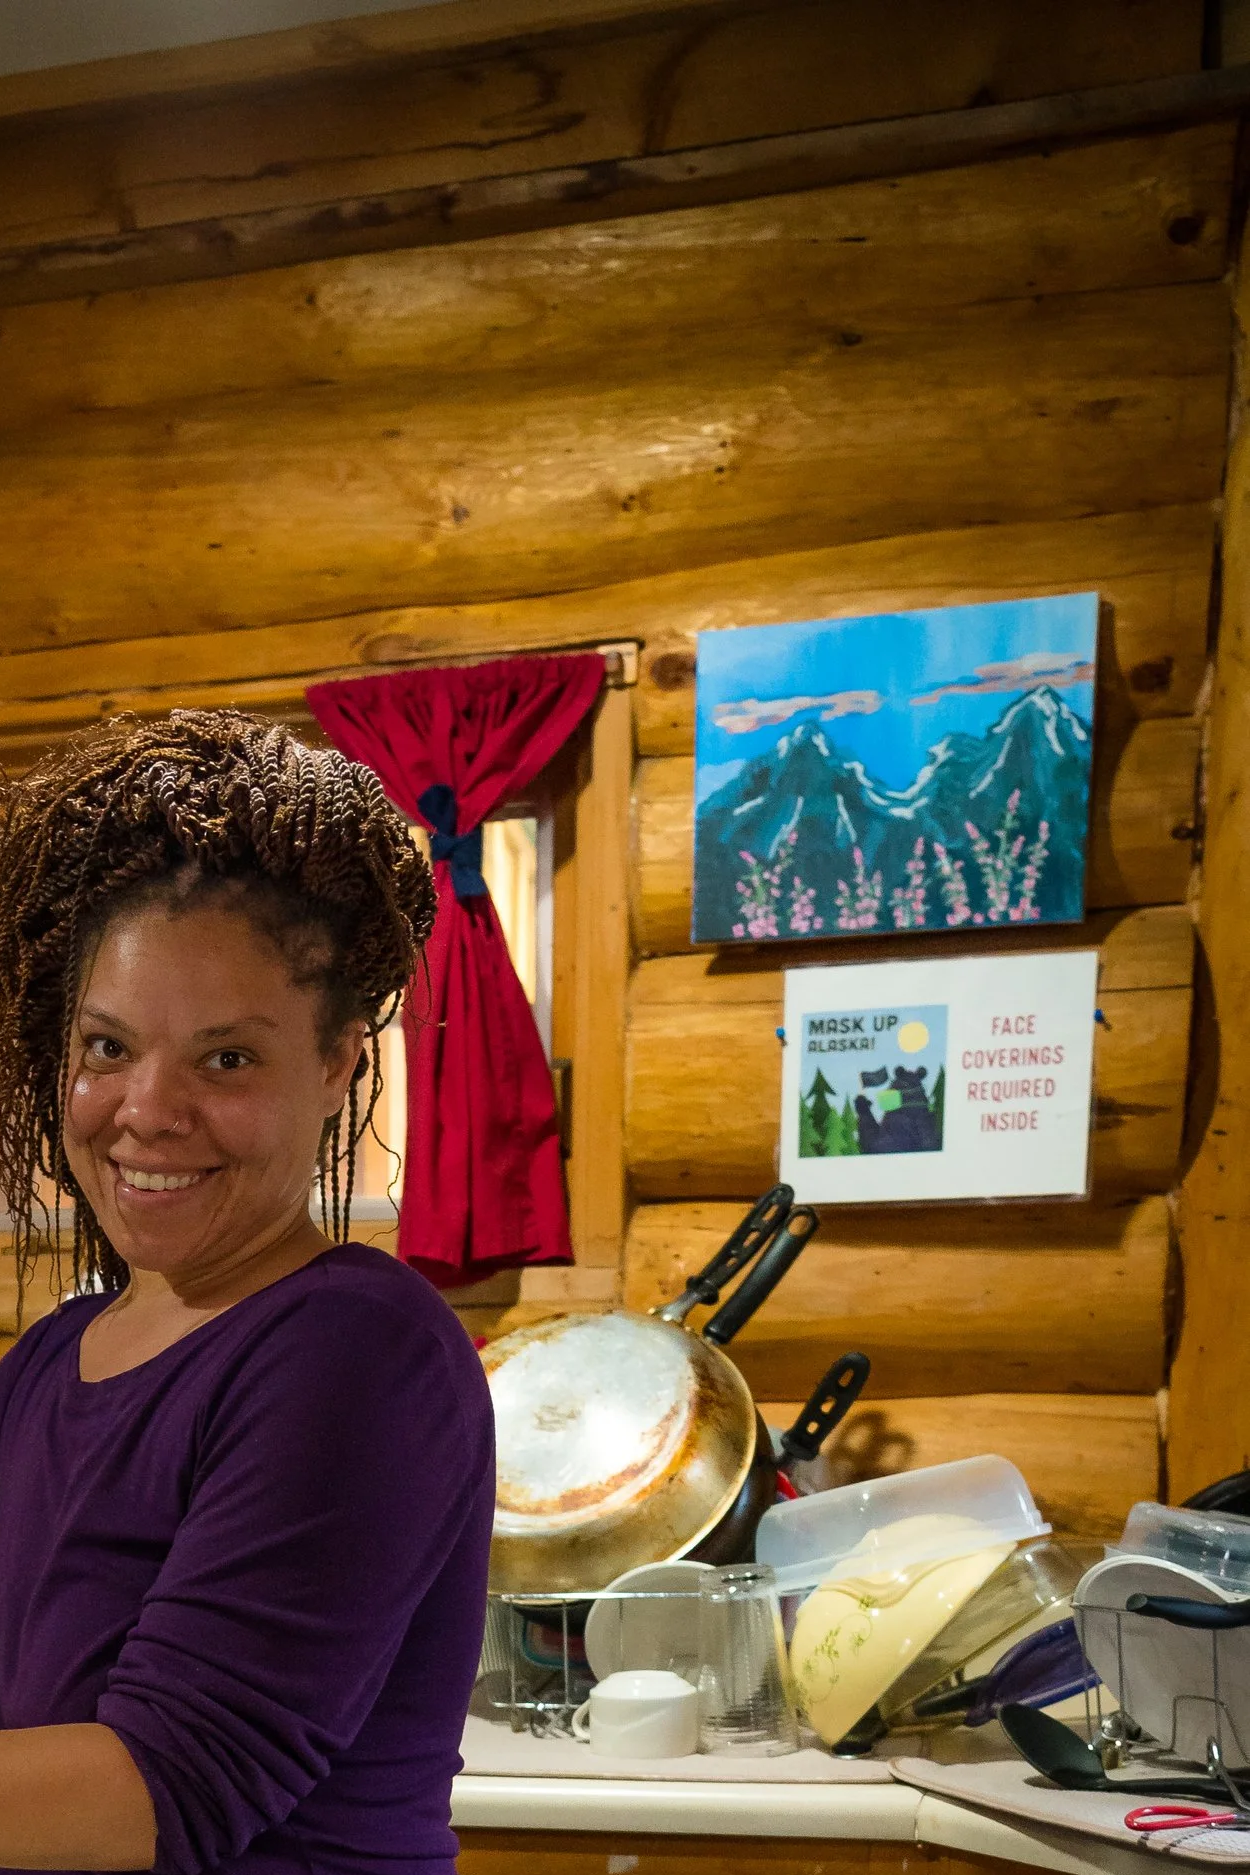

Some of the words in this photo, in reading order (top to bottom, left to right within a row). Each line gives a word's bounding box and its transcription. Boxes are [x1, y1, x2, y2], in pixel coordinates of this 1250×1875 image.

[809, 1016, 864, 1035] MASK
[874, 1015, 898, 1032] UP
[991, 1015, 1036, 1036] FACE
[808, 1036, 876, 1053] ALASKA!
[961, 1045, 1065, 1070] COVERINGS
[967, 1078, 1056, 1104] REQUIRED
[980, 1110, 1039, 1132] INSIDE
